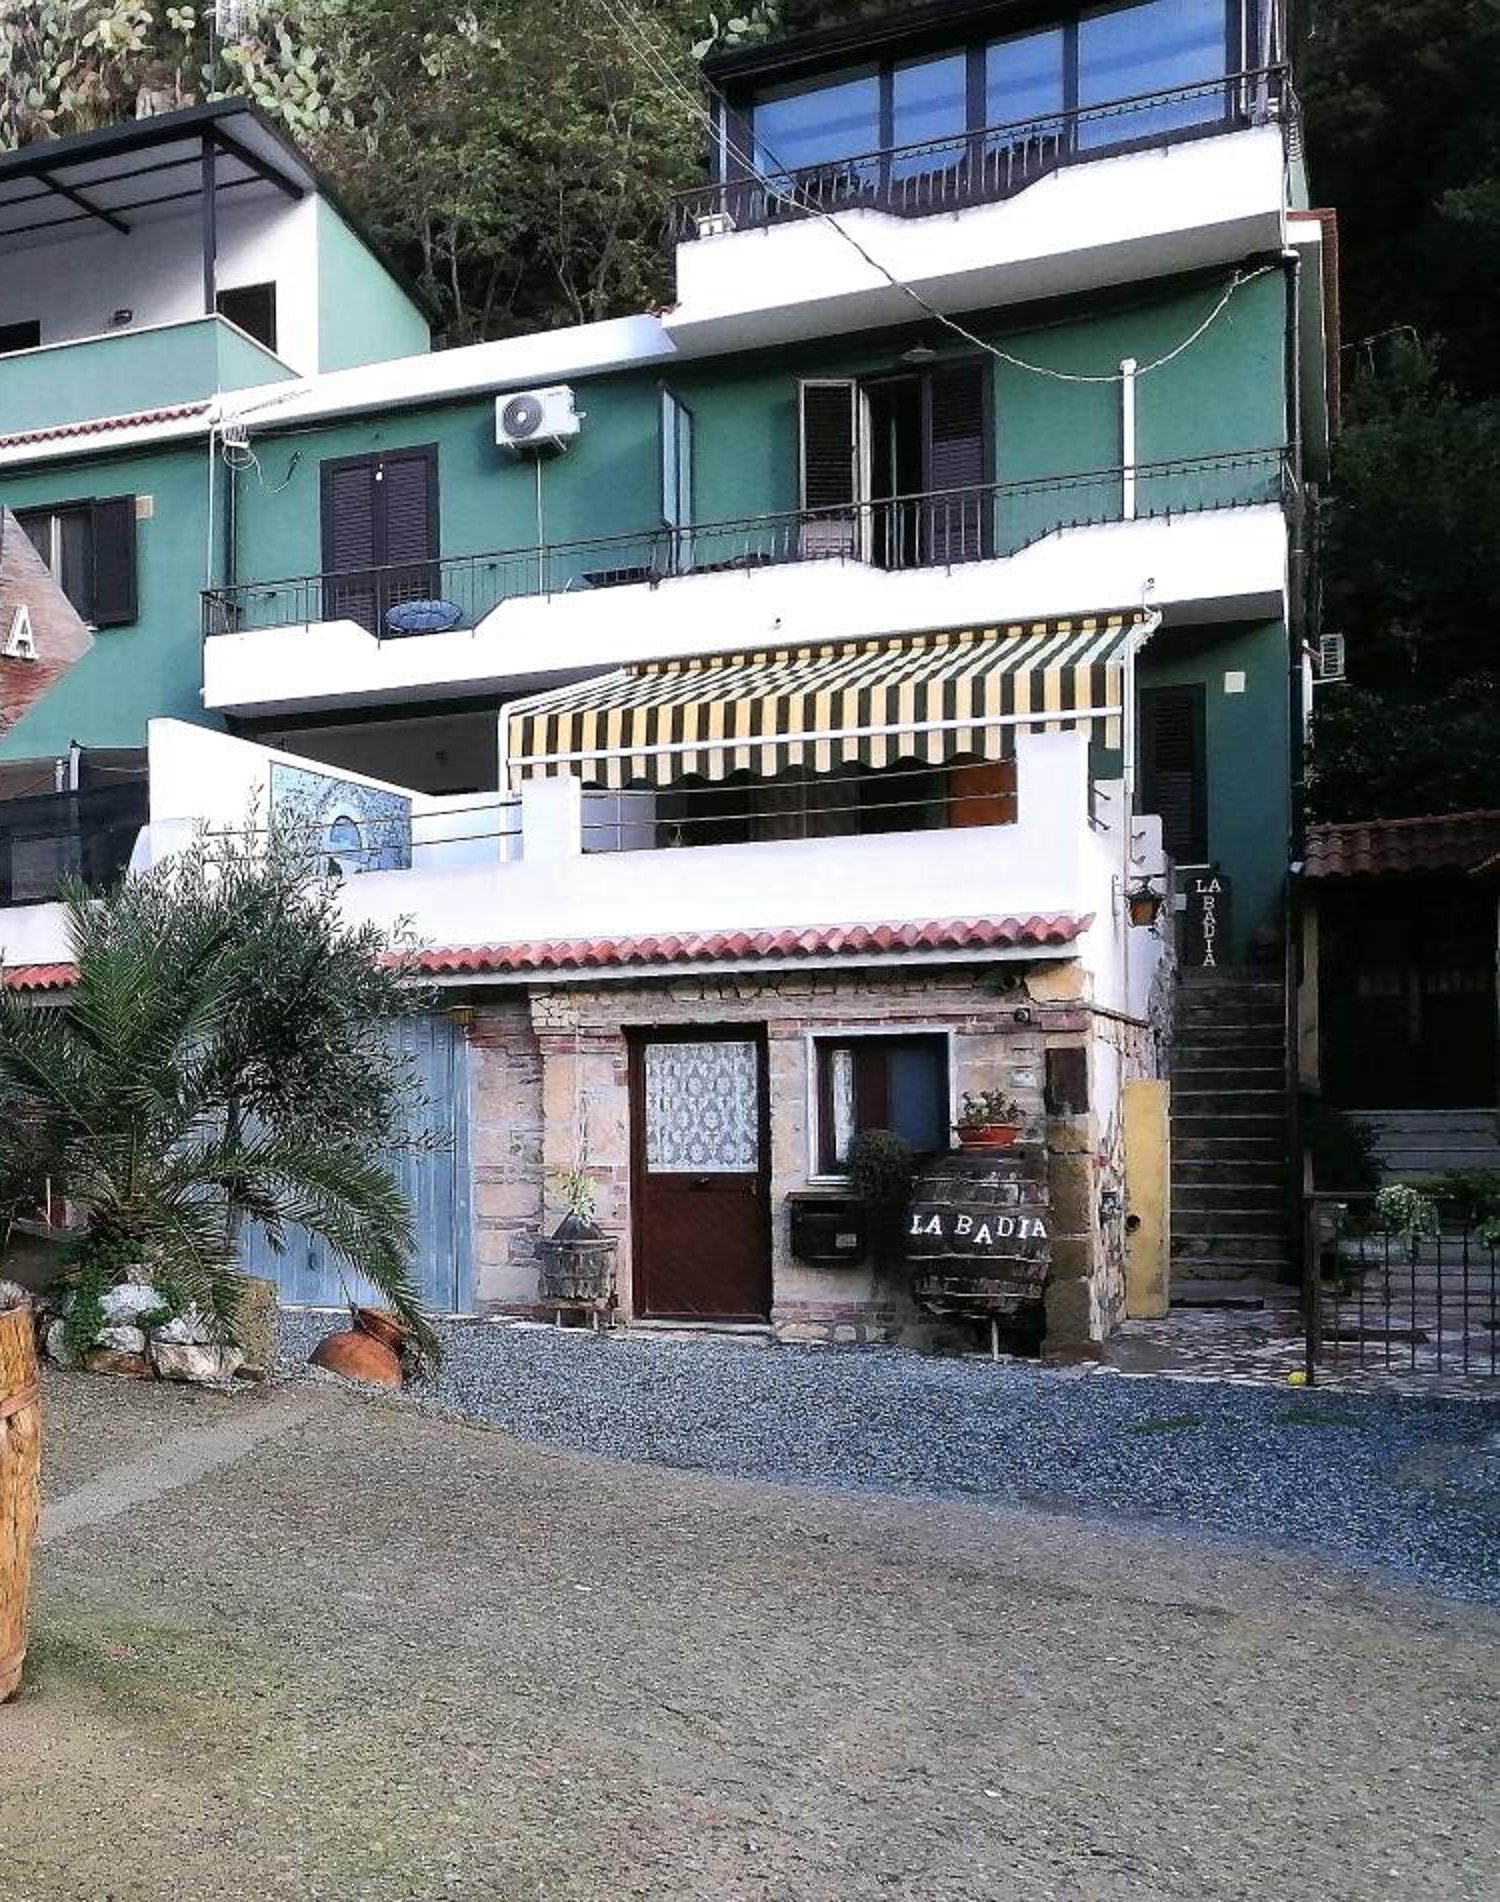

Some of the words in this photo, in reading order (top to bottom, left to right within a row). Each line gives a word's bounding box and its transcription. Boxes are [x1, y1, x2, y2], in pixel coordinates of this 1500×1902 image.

[1196, 877, 1221, 893] LA
[1202, 895, 1216, 967] BADIA
[909, 1214, 943, 1235] LA
[954, 1213, 1048, 1245] BADIA
